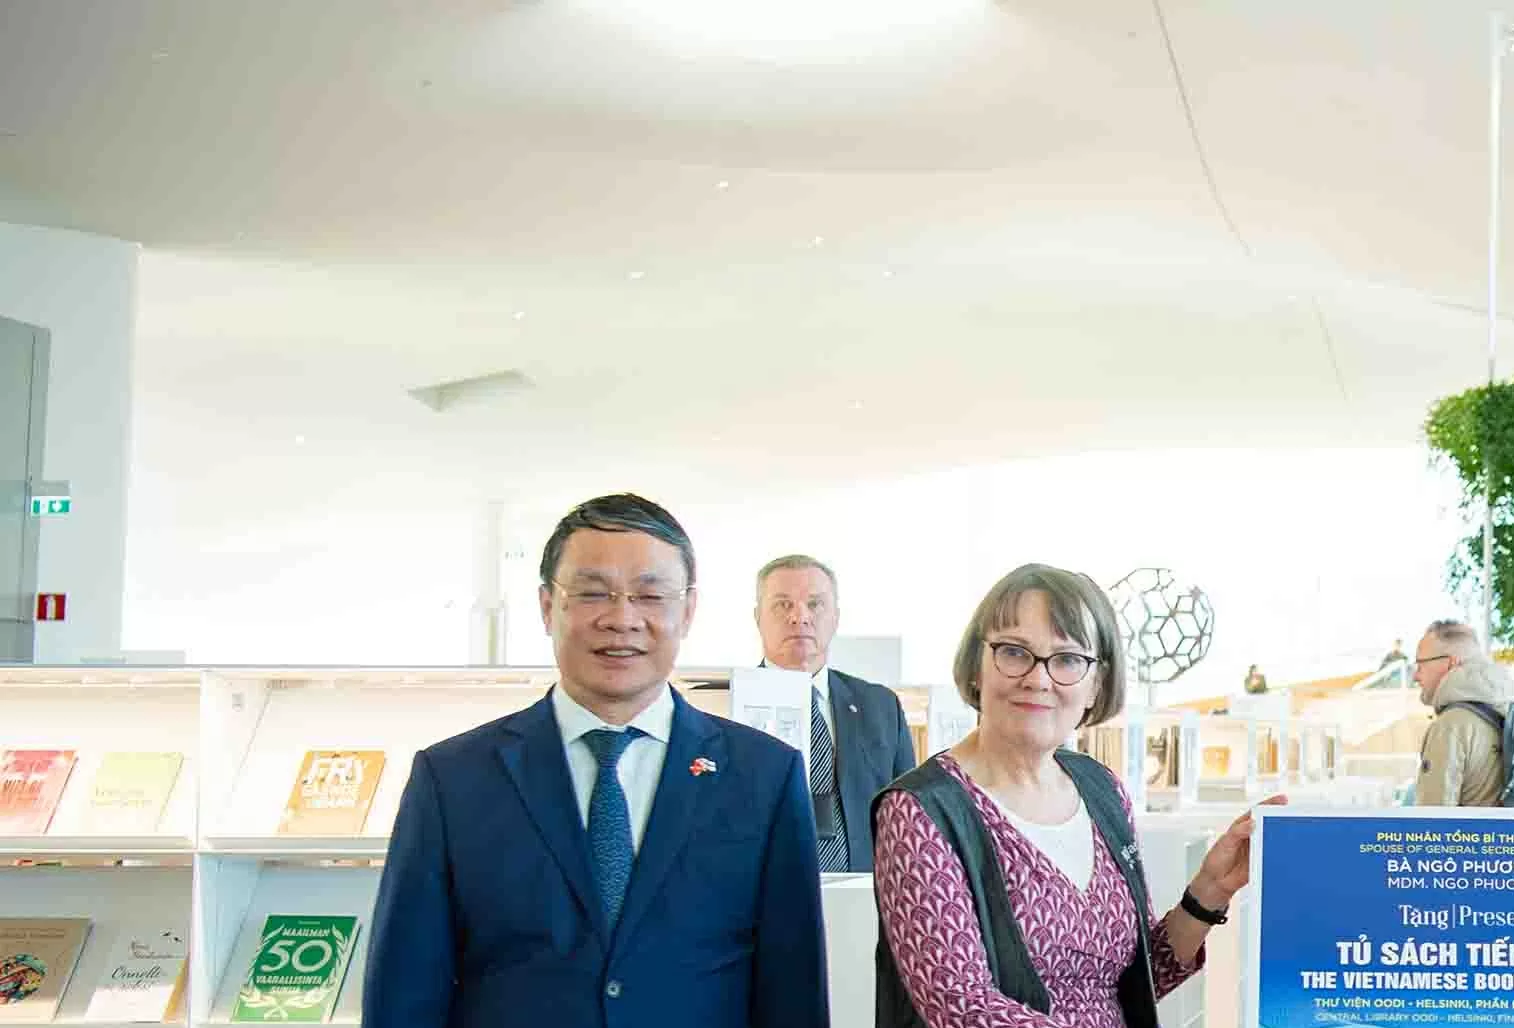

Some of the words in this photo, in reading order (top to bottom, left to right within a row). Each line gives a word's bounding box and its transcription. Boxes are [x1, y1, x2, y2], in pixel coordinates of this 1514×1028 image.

[1406, 832, 1442, 843] NHÂN
[1445, 830, 1480, 843] TỔNG
[1360, 844, 1402, 854] SPOUSE
[1406, 845, 1423, 854] OF
[1426, 845, 1478, 855] GENERAL
[1387, 857, 1411, 873] BÀ
[1418, 858, 1457, 873] NGÔ
[1388, 878, 1429, 889] MDM.
[1433, 878, 1469, 890] NGO
[261, 939, 333, 973] 50
[1336, 934, 1372, 966] TỦ
[1380, 938, 1458, 967] SÁCH
[1300, 971, 1337, 989] THE
[1343, 971, 1468, 990] VIETNAMESE
[1314, 998, 1340, 1008] THƯ
[1342, 996, 1371, 1009] VIỆN
[1374, 999, 1405, 1008] OODI
[1416, 999, 1472, 1010] HELSINKI,
[1315, 1013, 1362, 1022] CENTRAL
[1366, 1013, 1411, 1022] LIBRARY
[1412, 1014, 1438, 1022] OODI
[1448, 1014, 1495, 1024] HELSINKI,
